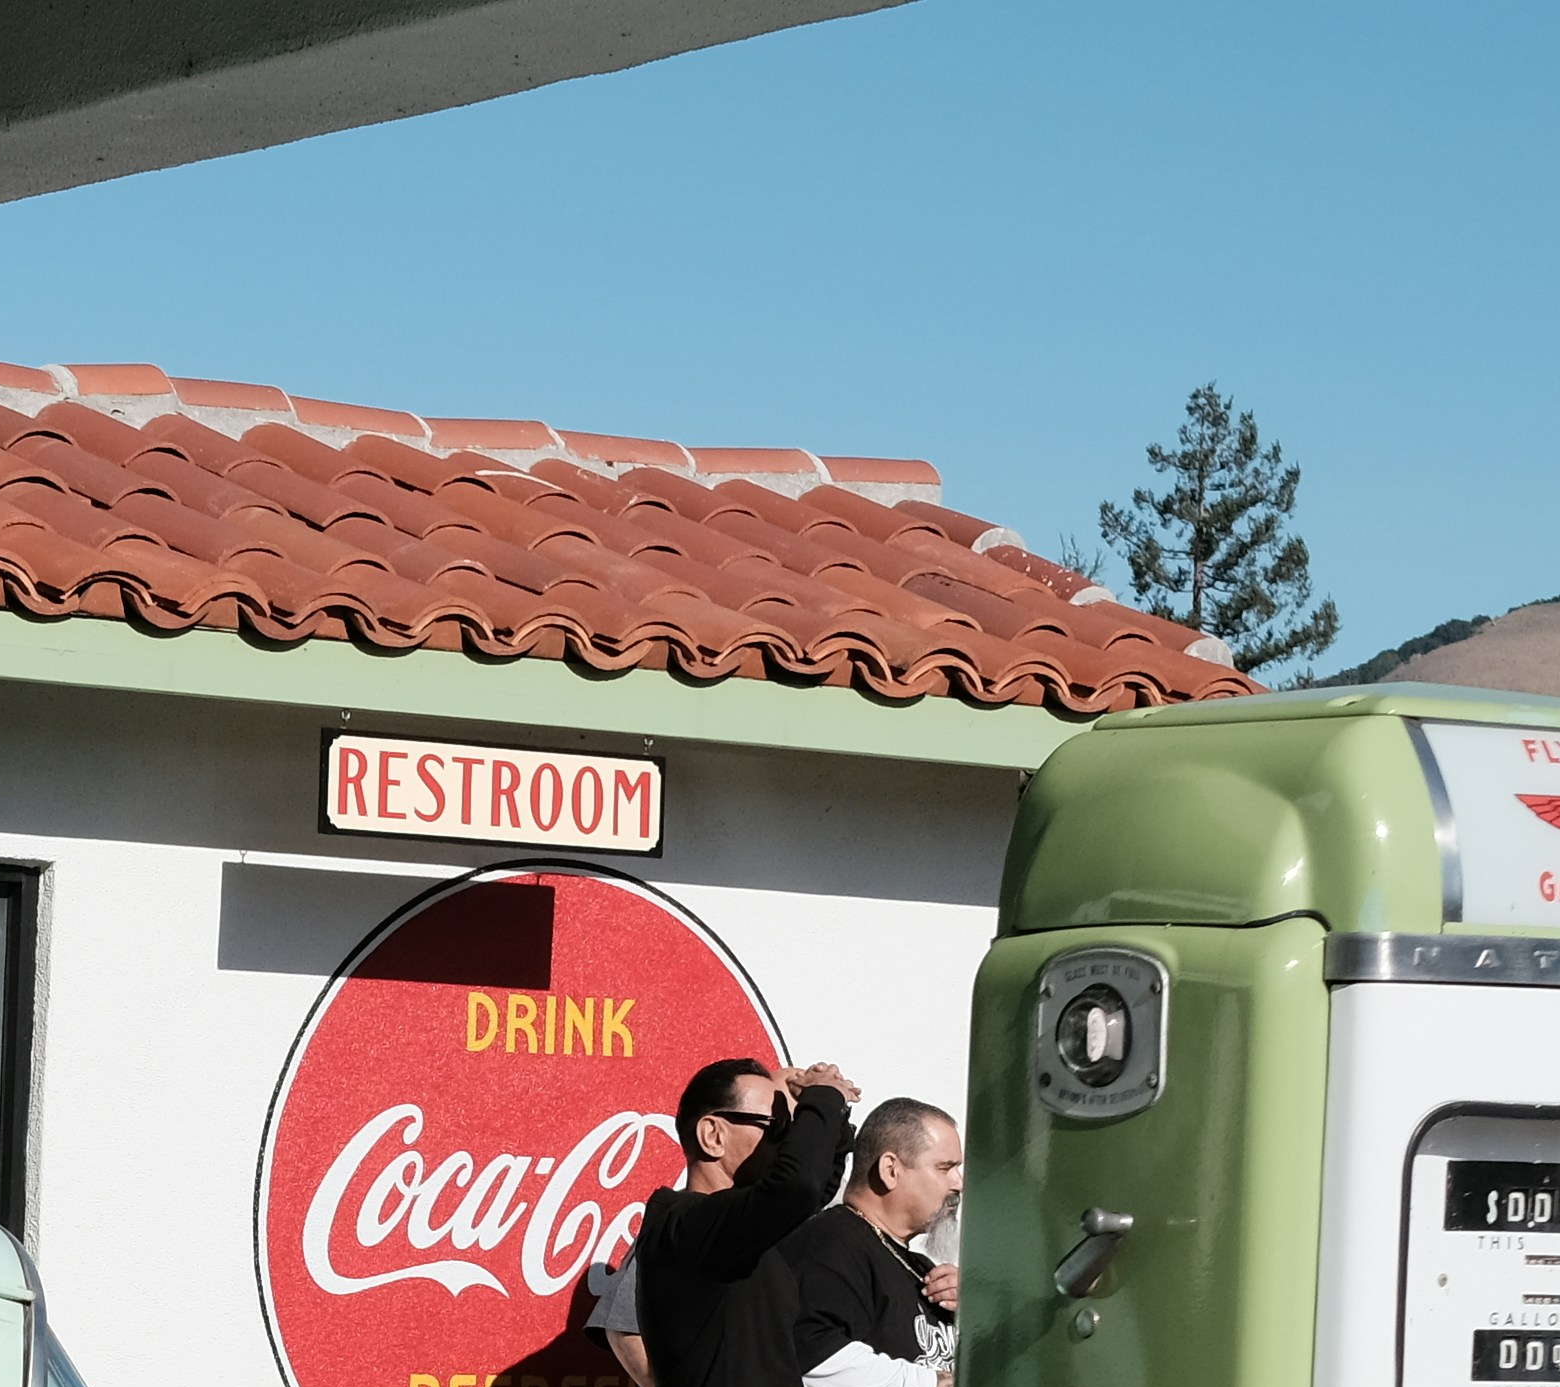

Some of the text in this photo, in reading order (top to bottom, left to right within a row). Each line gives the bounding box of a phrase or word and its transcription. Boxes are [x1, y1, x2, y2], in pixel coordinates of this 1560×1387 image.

[337, 746, 652, 840] RESTROOM
[466, 992, 636, 1058] DRINK
[301, 1102, 688, 1298] Coca-Co
[1478, 1236, 1525, 1250] THIS
